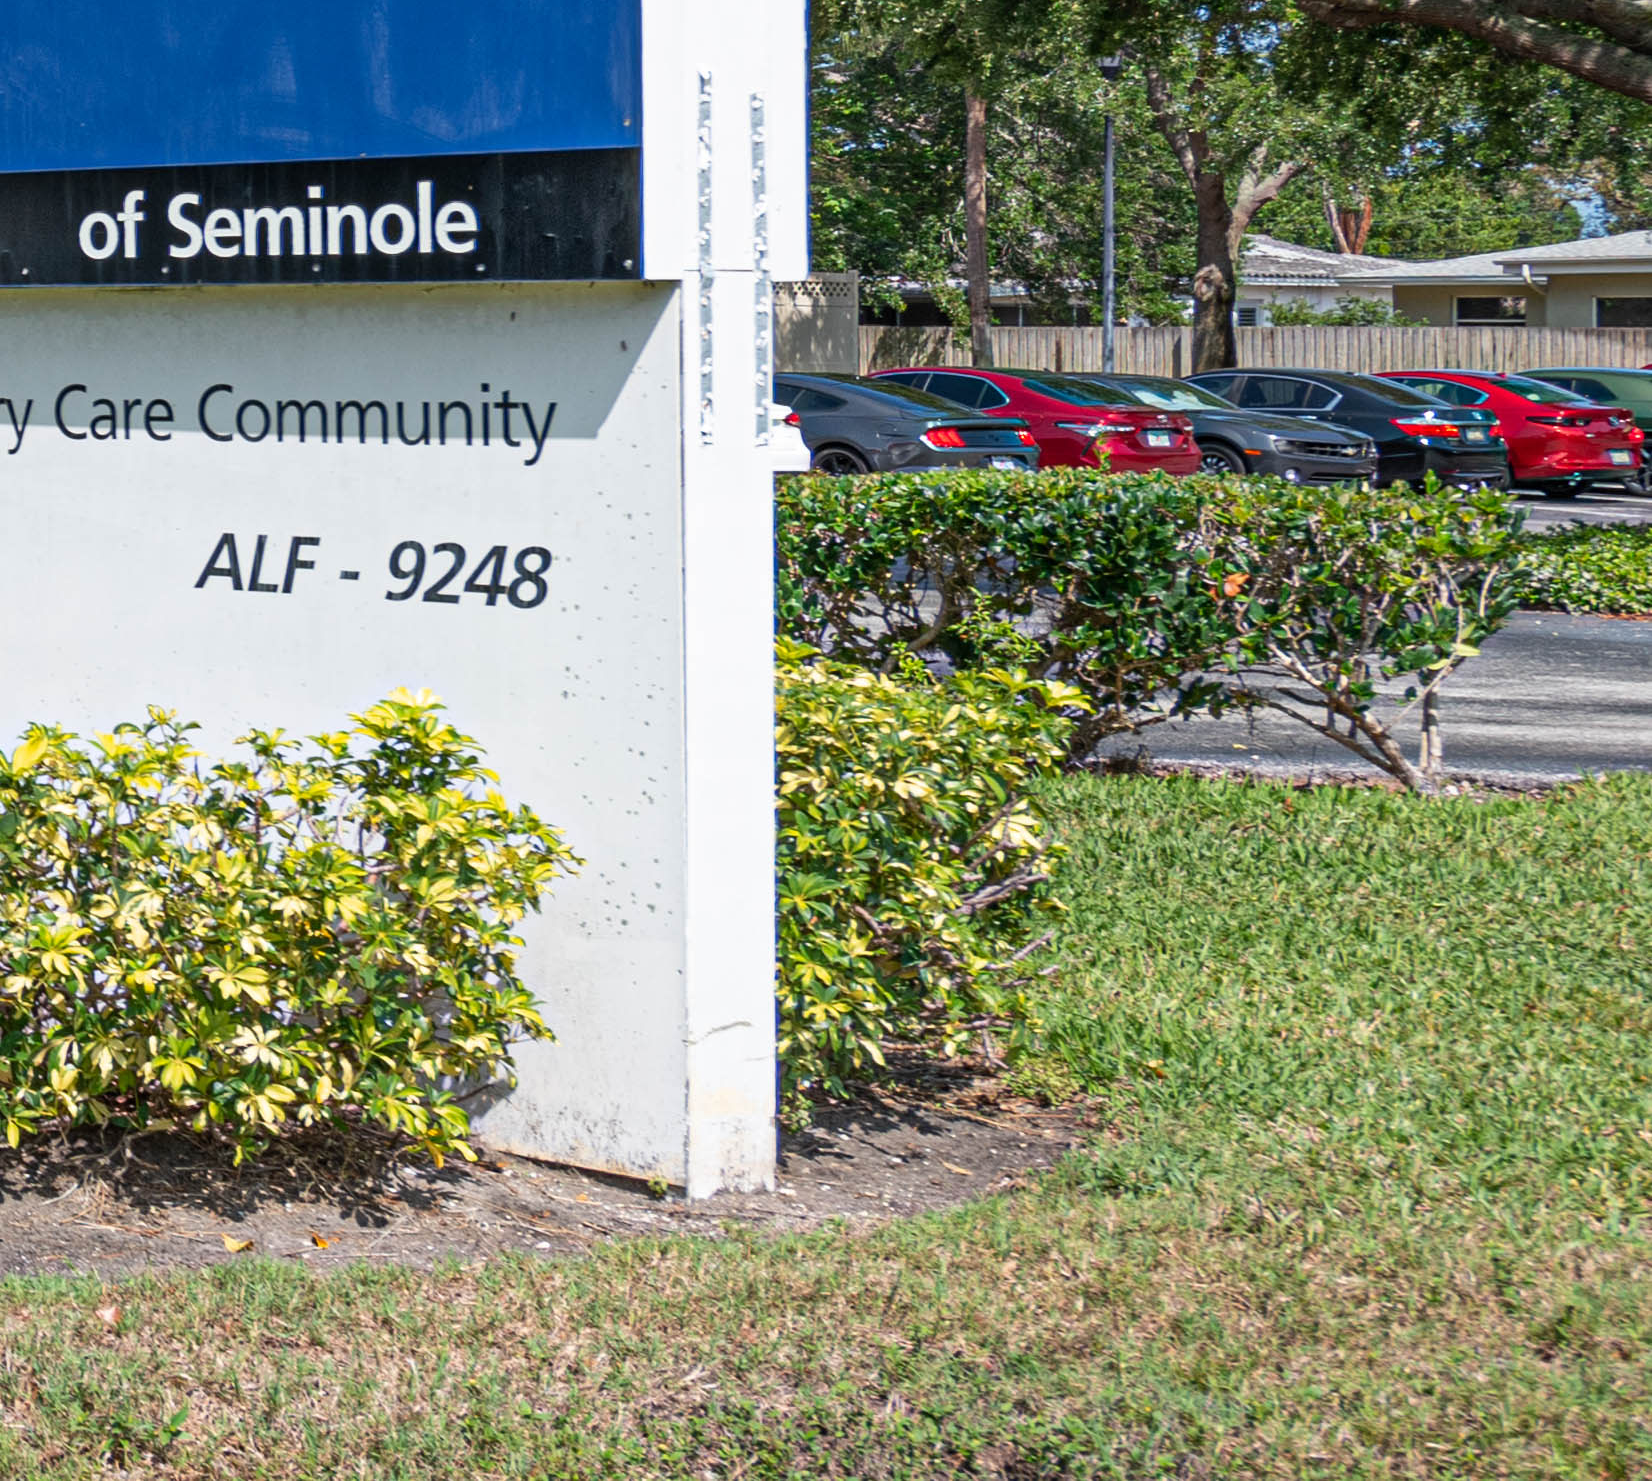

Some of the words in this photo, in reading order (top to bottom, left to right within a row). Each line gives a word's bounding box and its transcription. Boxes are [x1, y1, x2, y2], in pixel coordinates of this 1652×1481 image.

[78, 189, 145, 260] of
[167, 180, 478, 259] Seminole
[54, 382, 175, 441] Care
[197, 382, 559, 467] Community
[194, 531, 322, 594] ALF
[385, 539, 553, 609] 9248
